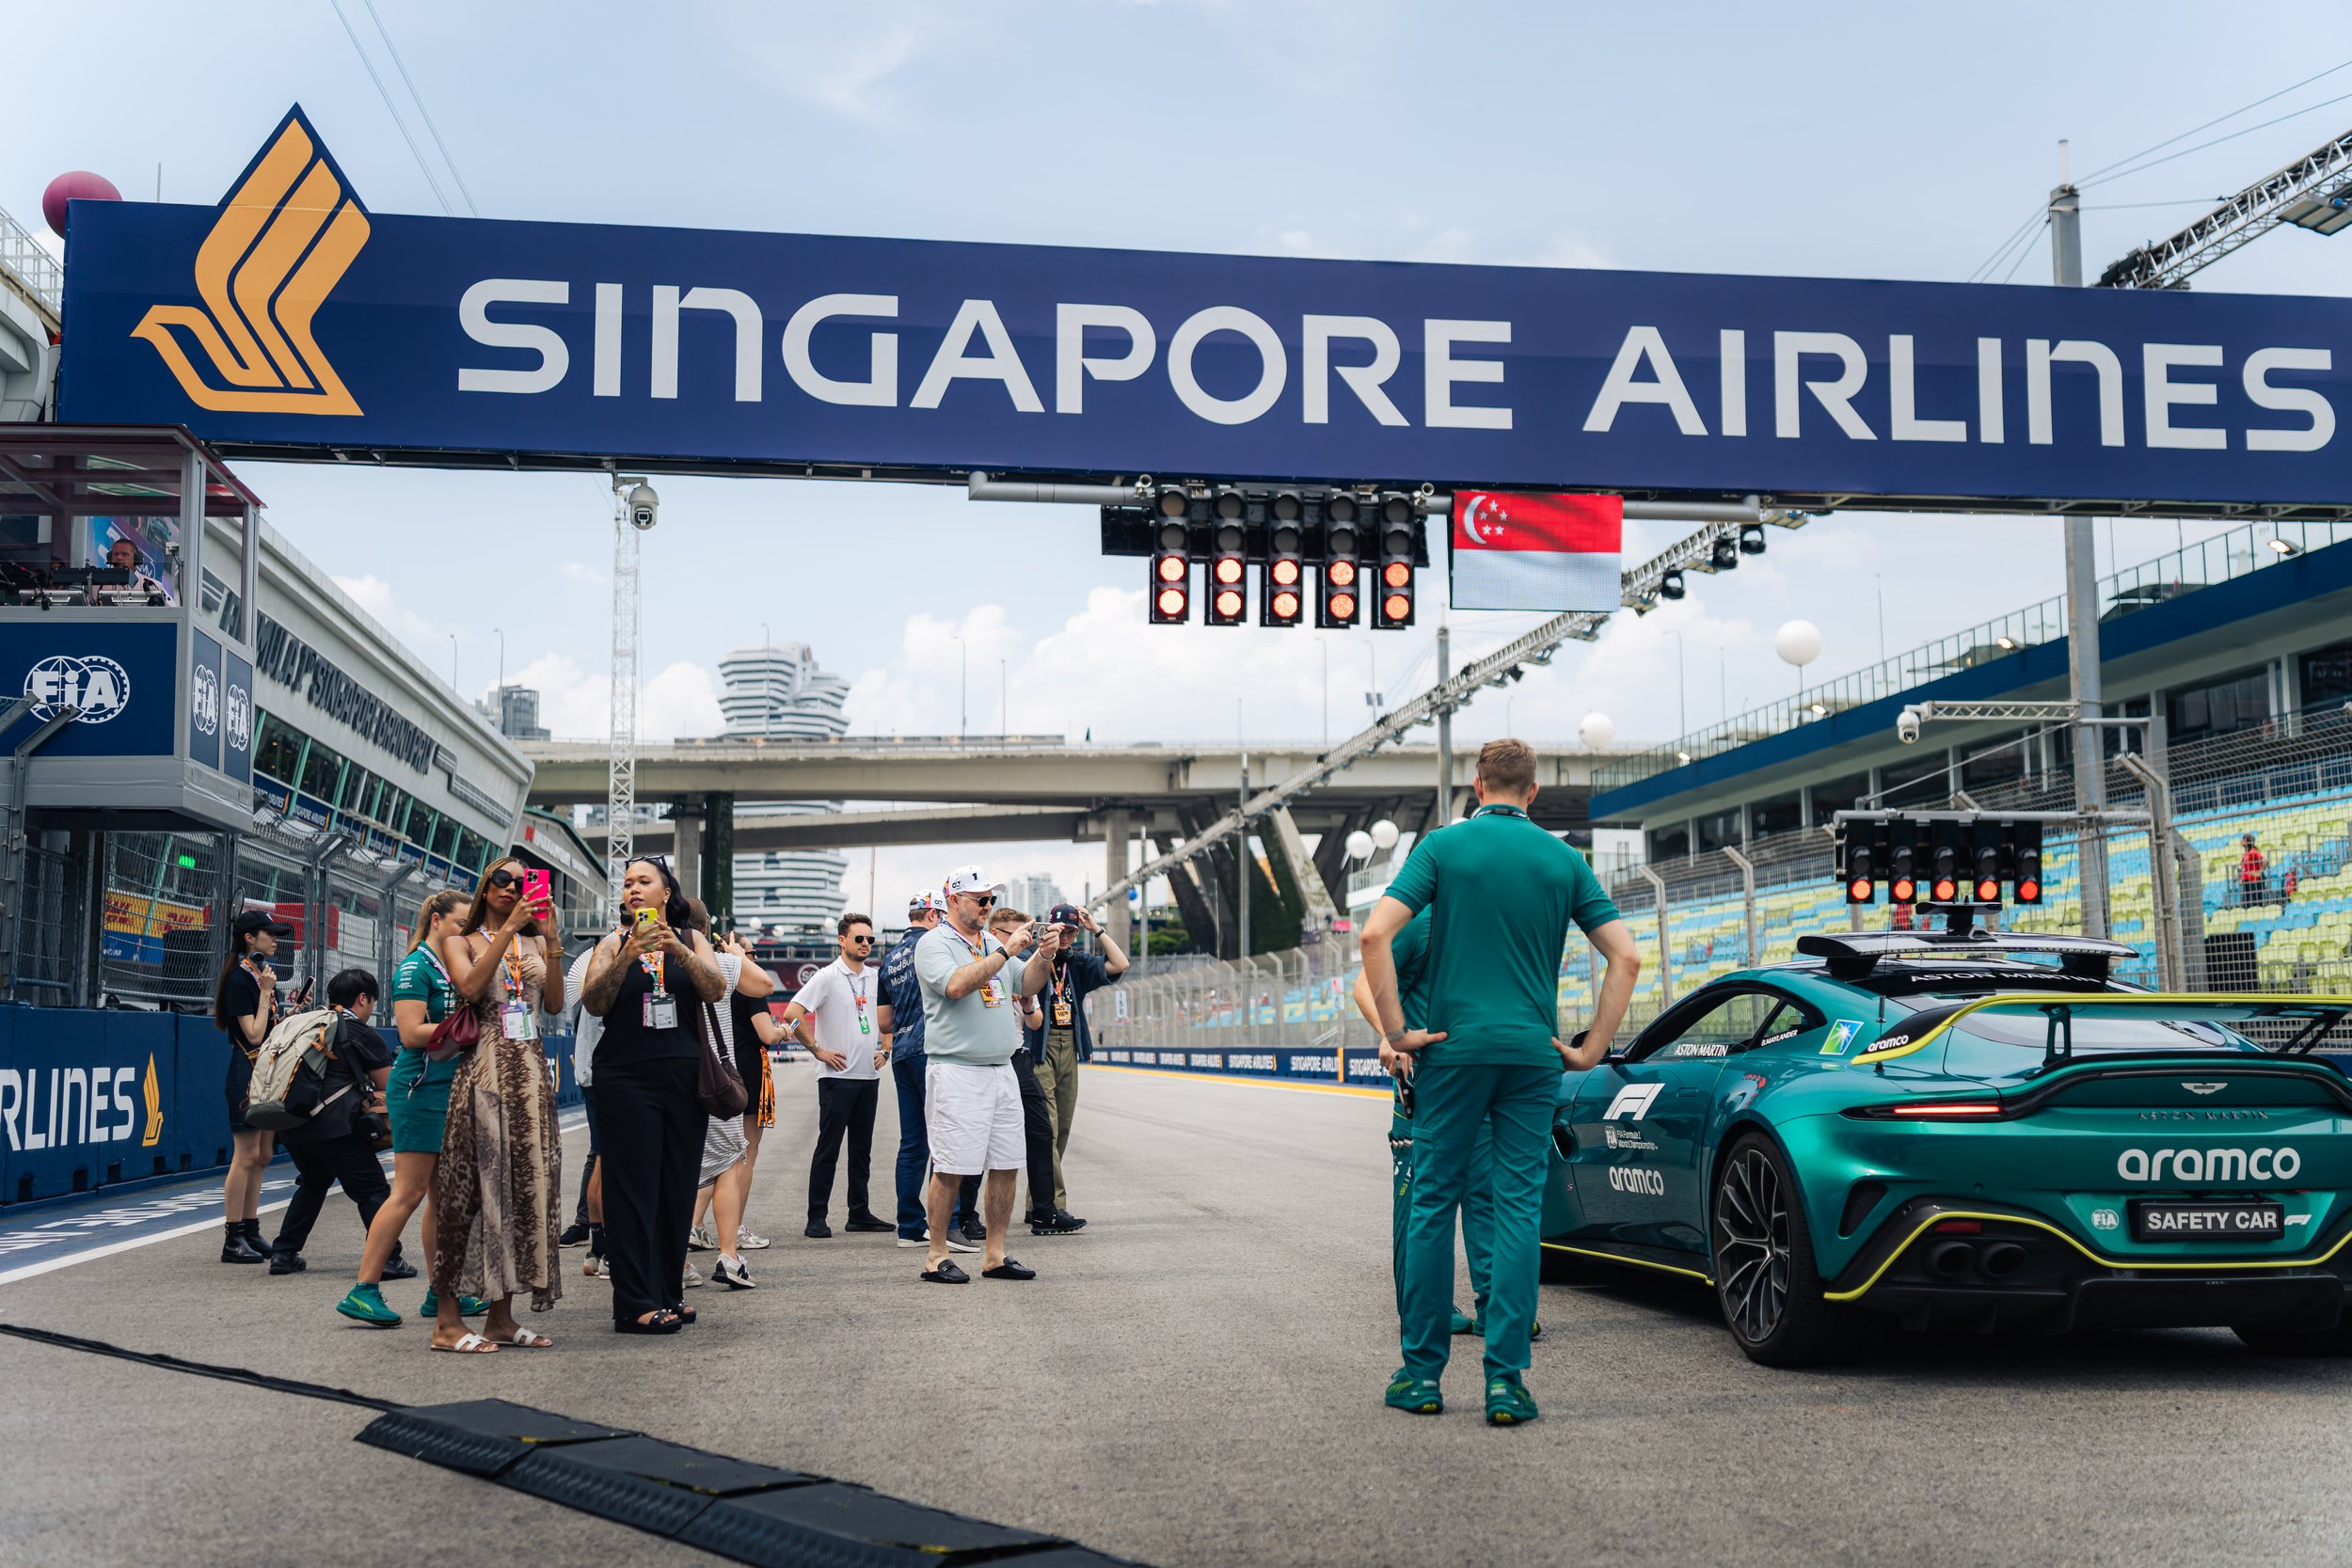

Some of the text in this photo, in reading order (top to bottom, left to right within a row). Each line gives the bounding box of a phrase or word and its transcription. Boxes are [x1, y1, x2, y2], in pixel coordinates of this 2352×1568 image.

[457, 277, 2336, 452] SINGAPORE AIRLINES
[1912, 972, 1994, 983] ASTON
[1675, 1044, 1729, 1056] ASTON MARTIN
[1867, 1035, 1909, 1052] aramco
[1291, 1055, 1321, 1071] SINGAPORE
[2117, 1147, 2301, 1181] aramco
[1610, 1166, 1664, 1196] aramco
[2148, 1212, 2278, 1229] SAFETY CAR
